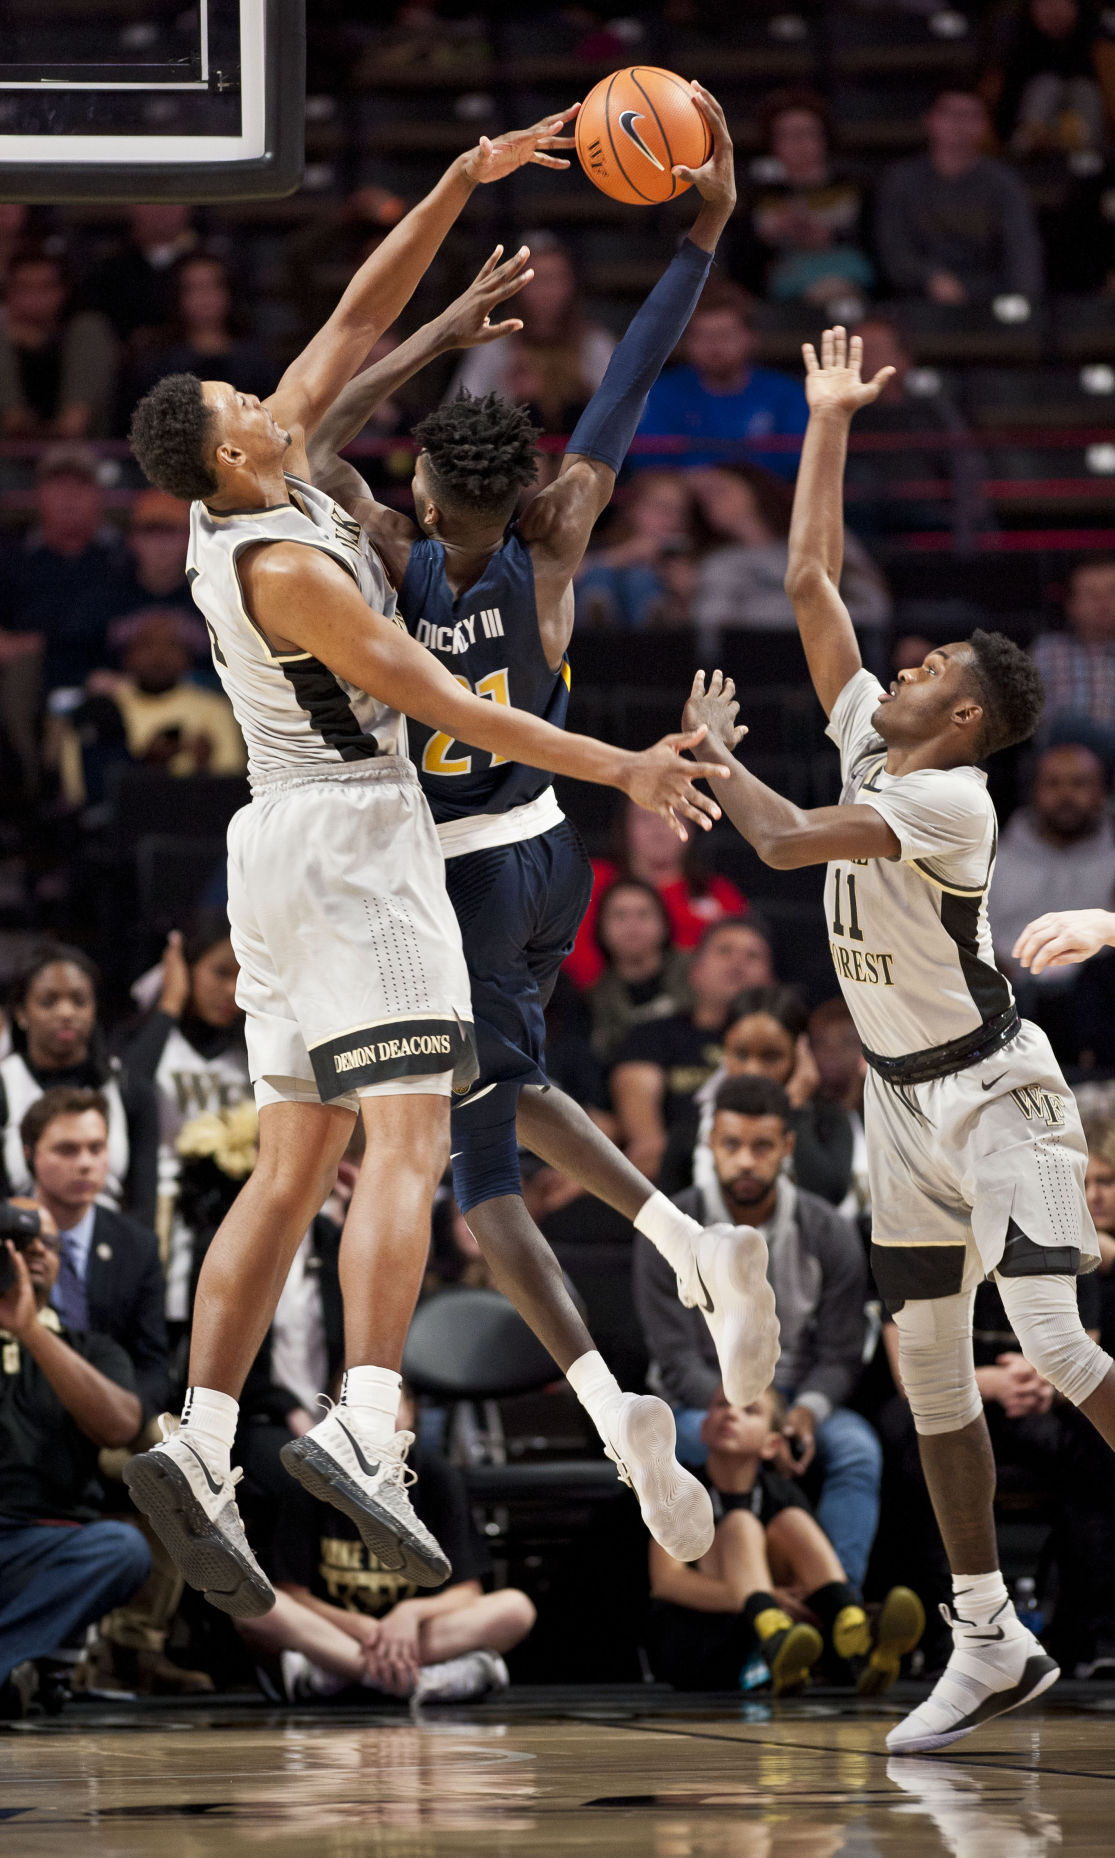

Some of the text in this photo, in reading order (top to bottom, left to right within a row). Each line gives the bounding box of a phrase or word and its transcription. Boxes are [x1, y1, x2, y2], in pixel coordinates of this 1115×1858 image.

[480, 608, 504, 638] III
[833, 868, 863, 941] 11
[831, 943, 895, 986] OREST
[333, 1035, 451, 1073] DEMON DEACONS
[1008, 1083, 1065, 1127] WF
